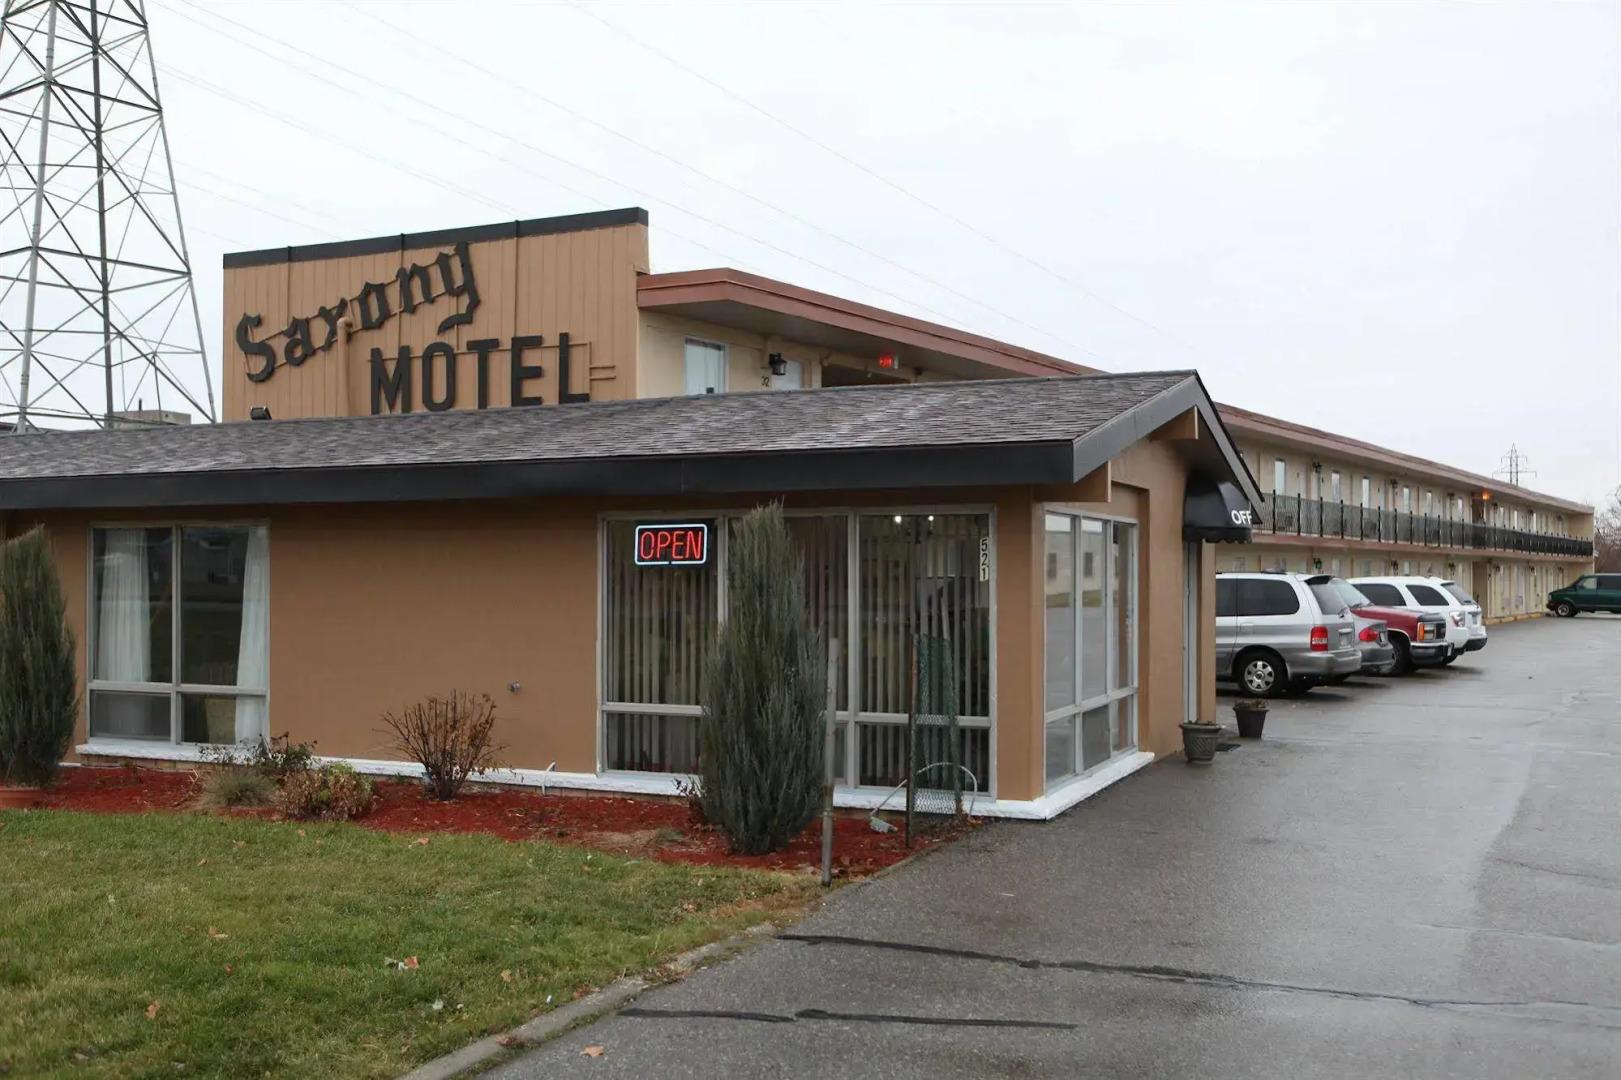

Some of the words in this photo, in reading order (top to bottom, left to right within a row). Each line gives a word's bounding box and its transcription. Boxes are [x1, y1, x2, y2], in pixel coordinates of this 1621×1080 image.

[236, 242, 480, 383] Saxony
[371, 333, 590, 415] MOTEL
[640, 531, 703, 559] OPEN
